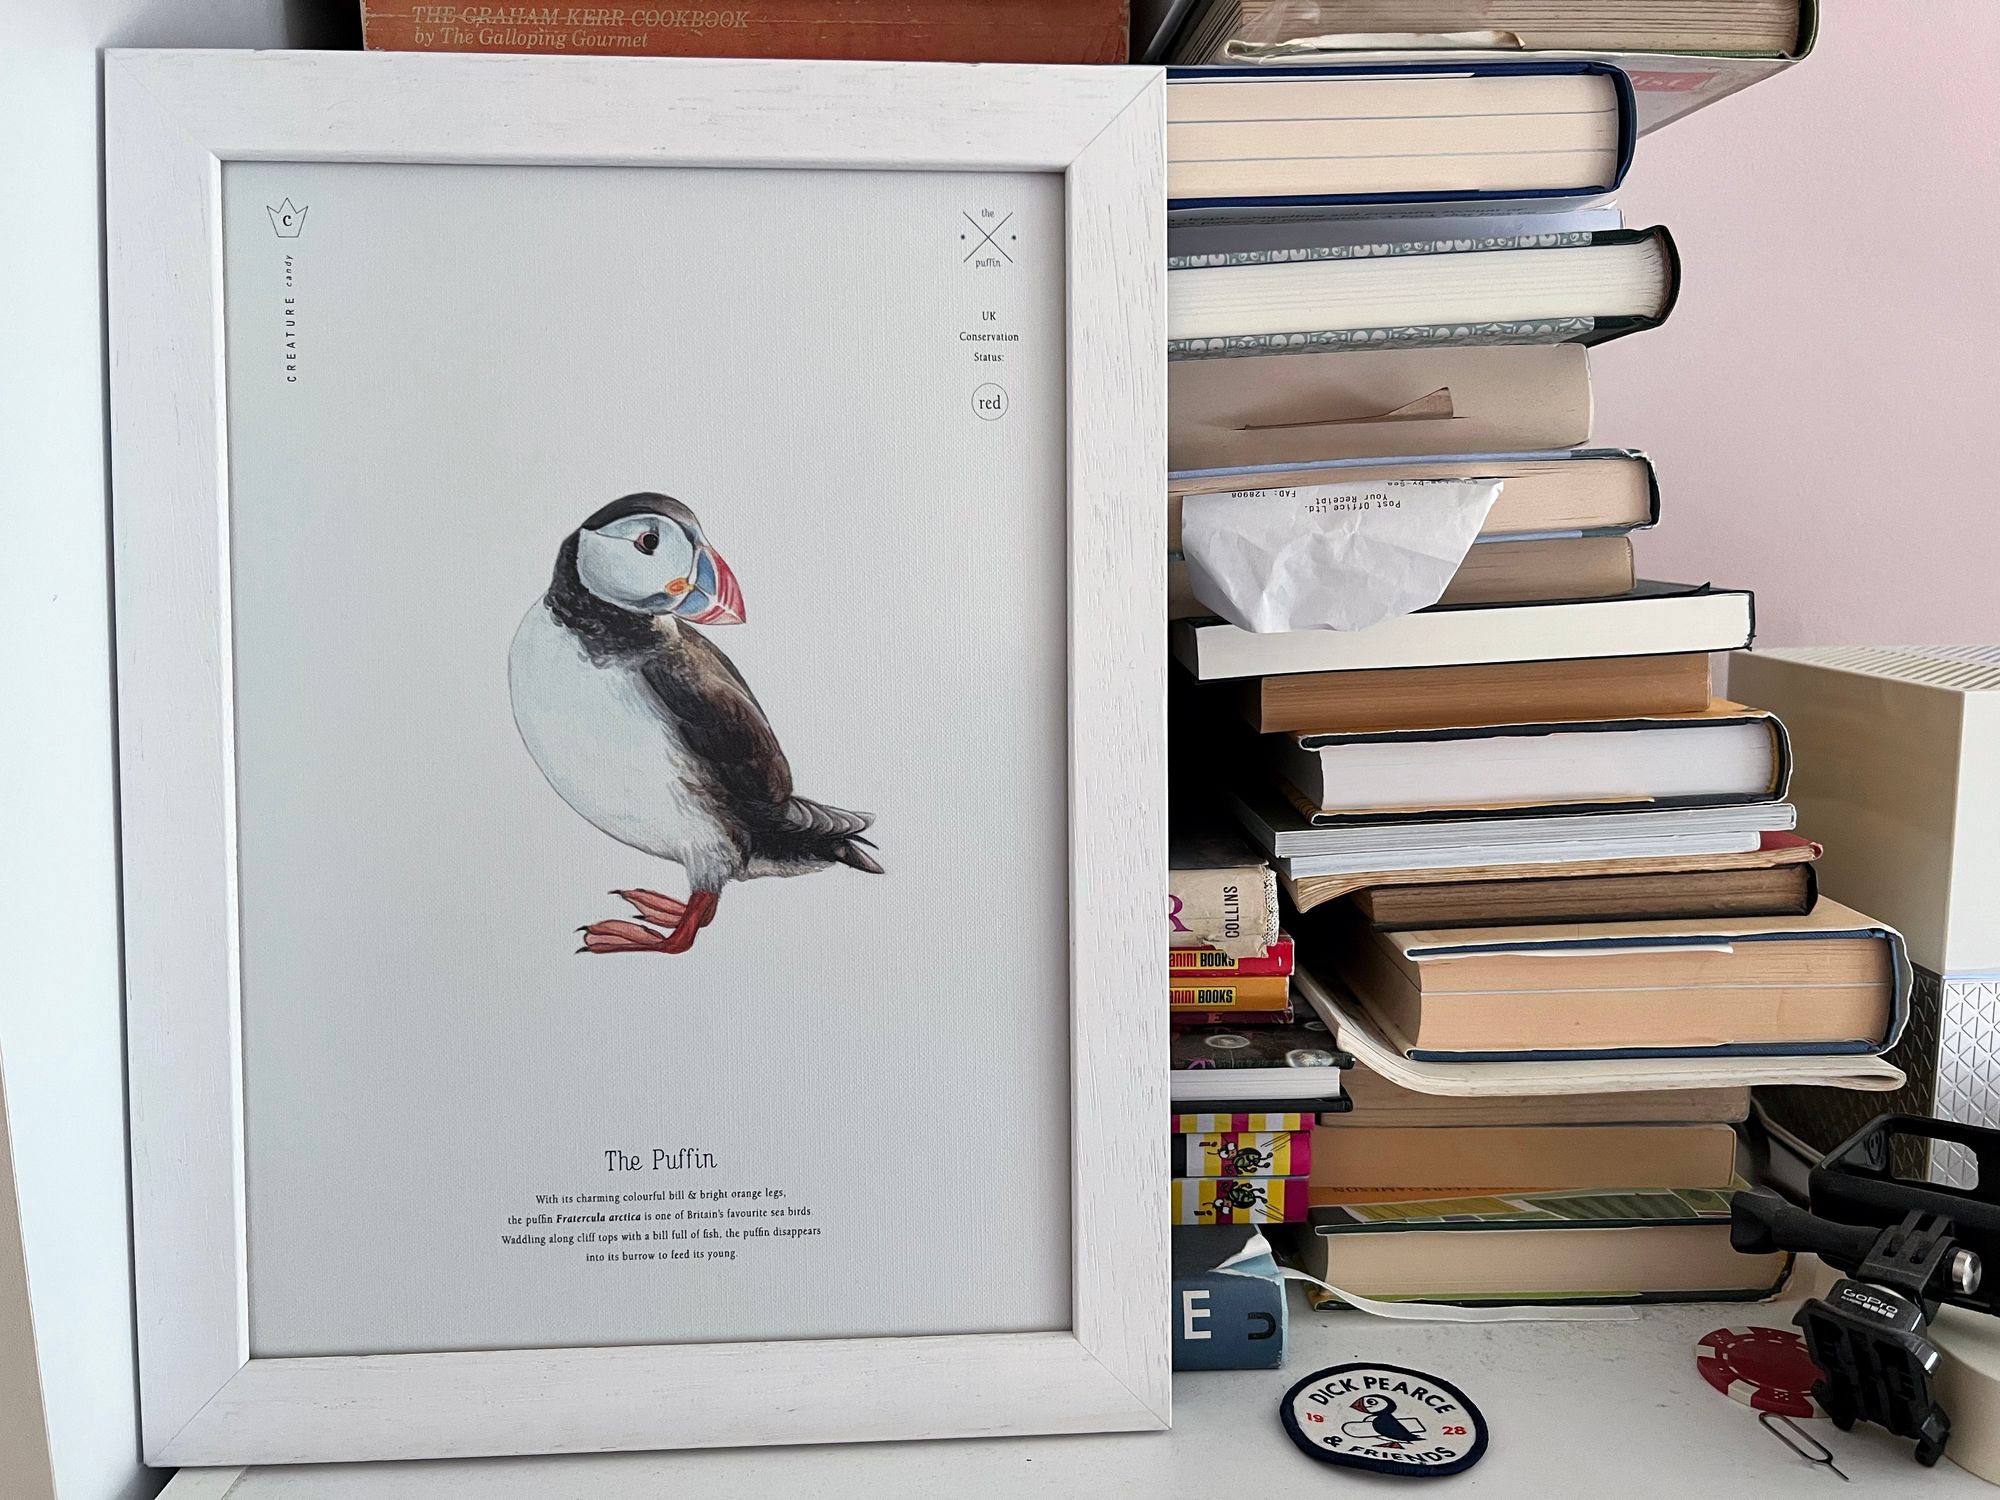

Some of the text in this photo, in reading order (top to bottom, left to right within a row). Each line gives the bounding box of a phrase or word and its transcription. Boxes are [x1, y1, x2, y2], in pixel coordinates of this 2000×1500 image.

[412, 6, 749, 29] THE GRAHAM KERR COOKBOOK
[414, 27, 648, 49] by The Galloping Gourmet
[981, 208, 995, 218] the
[975, 258, 1001, 269] puffin
[285, 255, 297, 383] CREATURE candy
[982, 311, 996, 321] UK
[959, 332, 1019, 342] Conservation
[974, 352, 1005, 362] Status:
[979, 395, 1001, 410] red
[1274, 490, 1296, 498] FAD:
[1315, 493, 1388, 505] Your Receipt
[1304, 500, 1401, 513] Post Office Ltd.
[1224, 885, 1240, 938] COLLINS
[1169, 952, 1235, 967] anini BOOKS
[1169, 989, 1233, 1004] anini BOOKS
[605, 1148, 718, 1171] The Puffin
[536, 1187, 786, 1204] With its charming colourful bill & bright orange legs,
[508, 1215, 523, 1225] the
[526, 1214, 553, 1227] puffin
[556, 1212, 606, 1224] Fratercula
[609, 1212, 641, 1222] arctica
[644, 1212, 652, 1221] is
[655, 1212, 671, 1220] one
[675, 1209, 684, 1220] of
[687, 1209, 724, 1220] Britain's
[727, 1208, 767, 1218] favourite
[771, 1209, 785, 1217] sea
[501, 1234, 546, 1246] Waddling
[549, 1233, 574, 1245] along
[577, 1232, 596, 1243] cliff
[599, 1233, 618, 1244] tops
[621, 1231, 642, 1241] with
[653, 1230, 669, 1240] bill
[672, 1229, 688, 1240] full
[690, 1229, 700, 1239] of
[703, 1228, 722, 1239] fish,
[726, 1228, 740, 1238] the
[743, 1227, 770, 1240] puffin
[773, 1226, 821, 1239] disappears
[586, 1249, 738, 1262] into its burrow to feed its young.
[1843, 1288, 1898, 1314] GoPro
[1309, 1376, 1457, 1415] DICK PEARCE
[1306, 1412, 1468, 1435] 19 28
[1322, 1435, 1456, 1463] & FRIENDS
